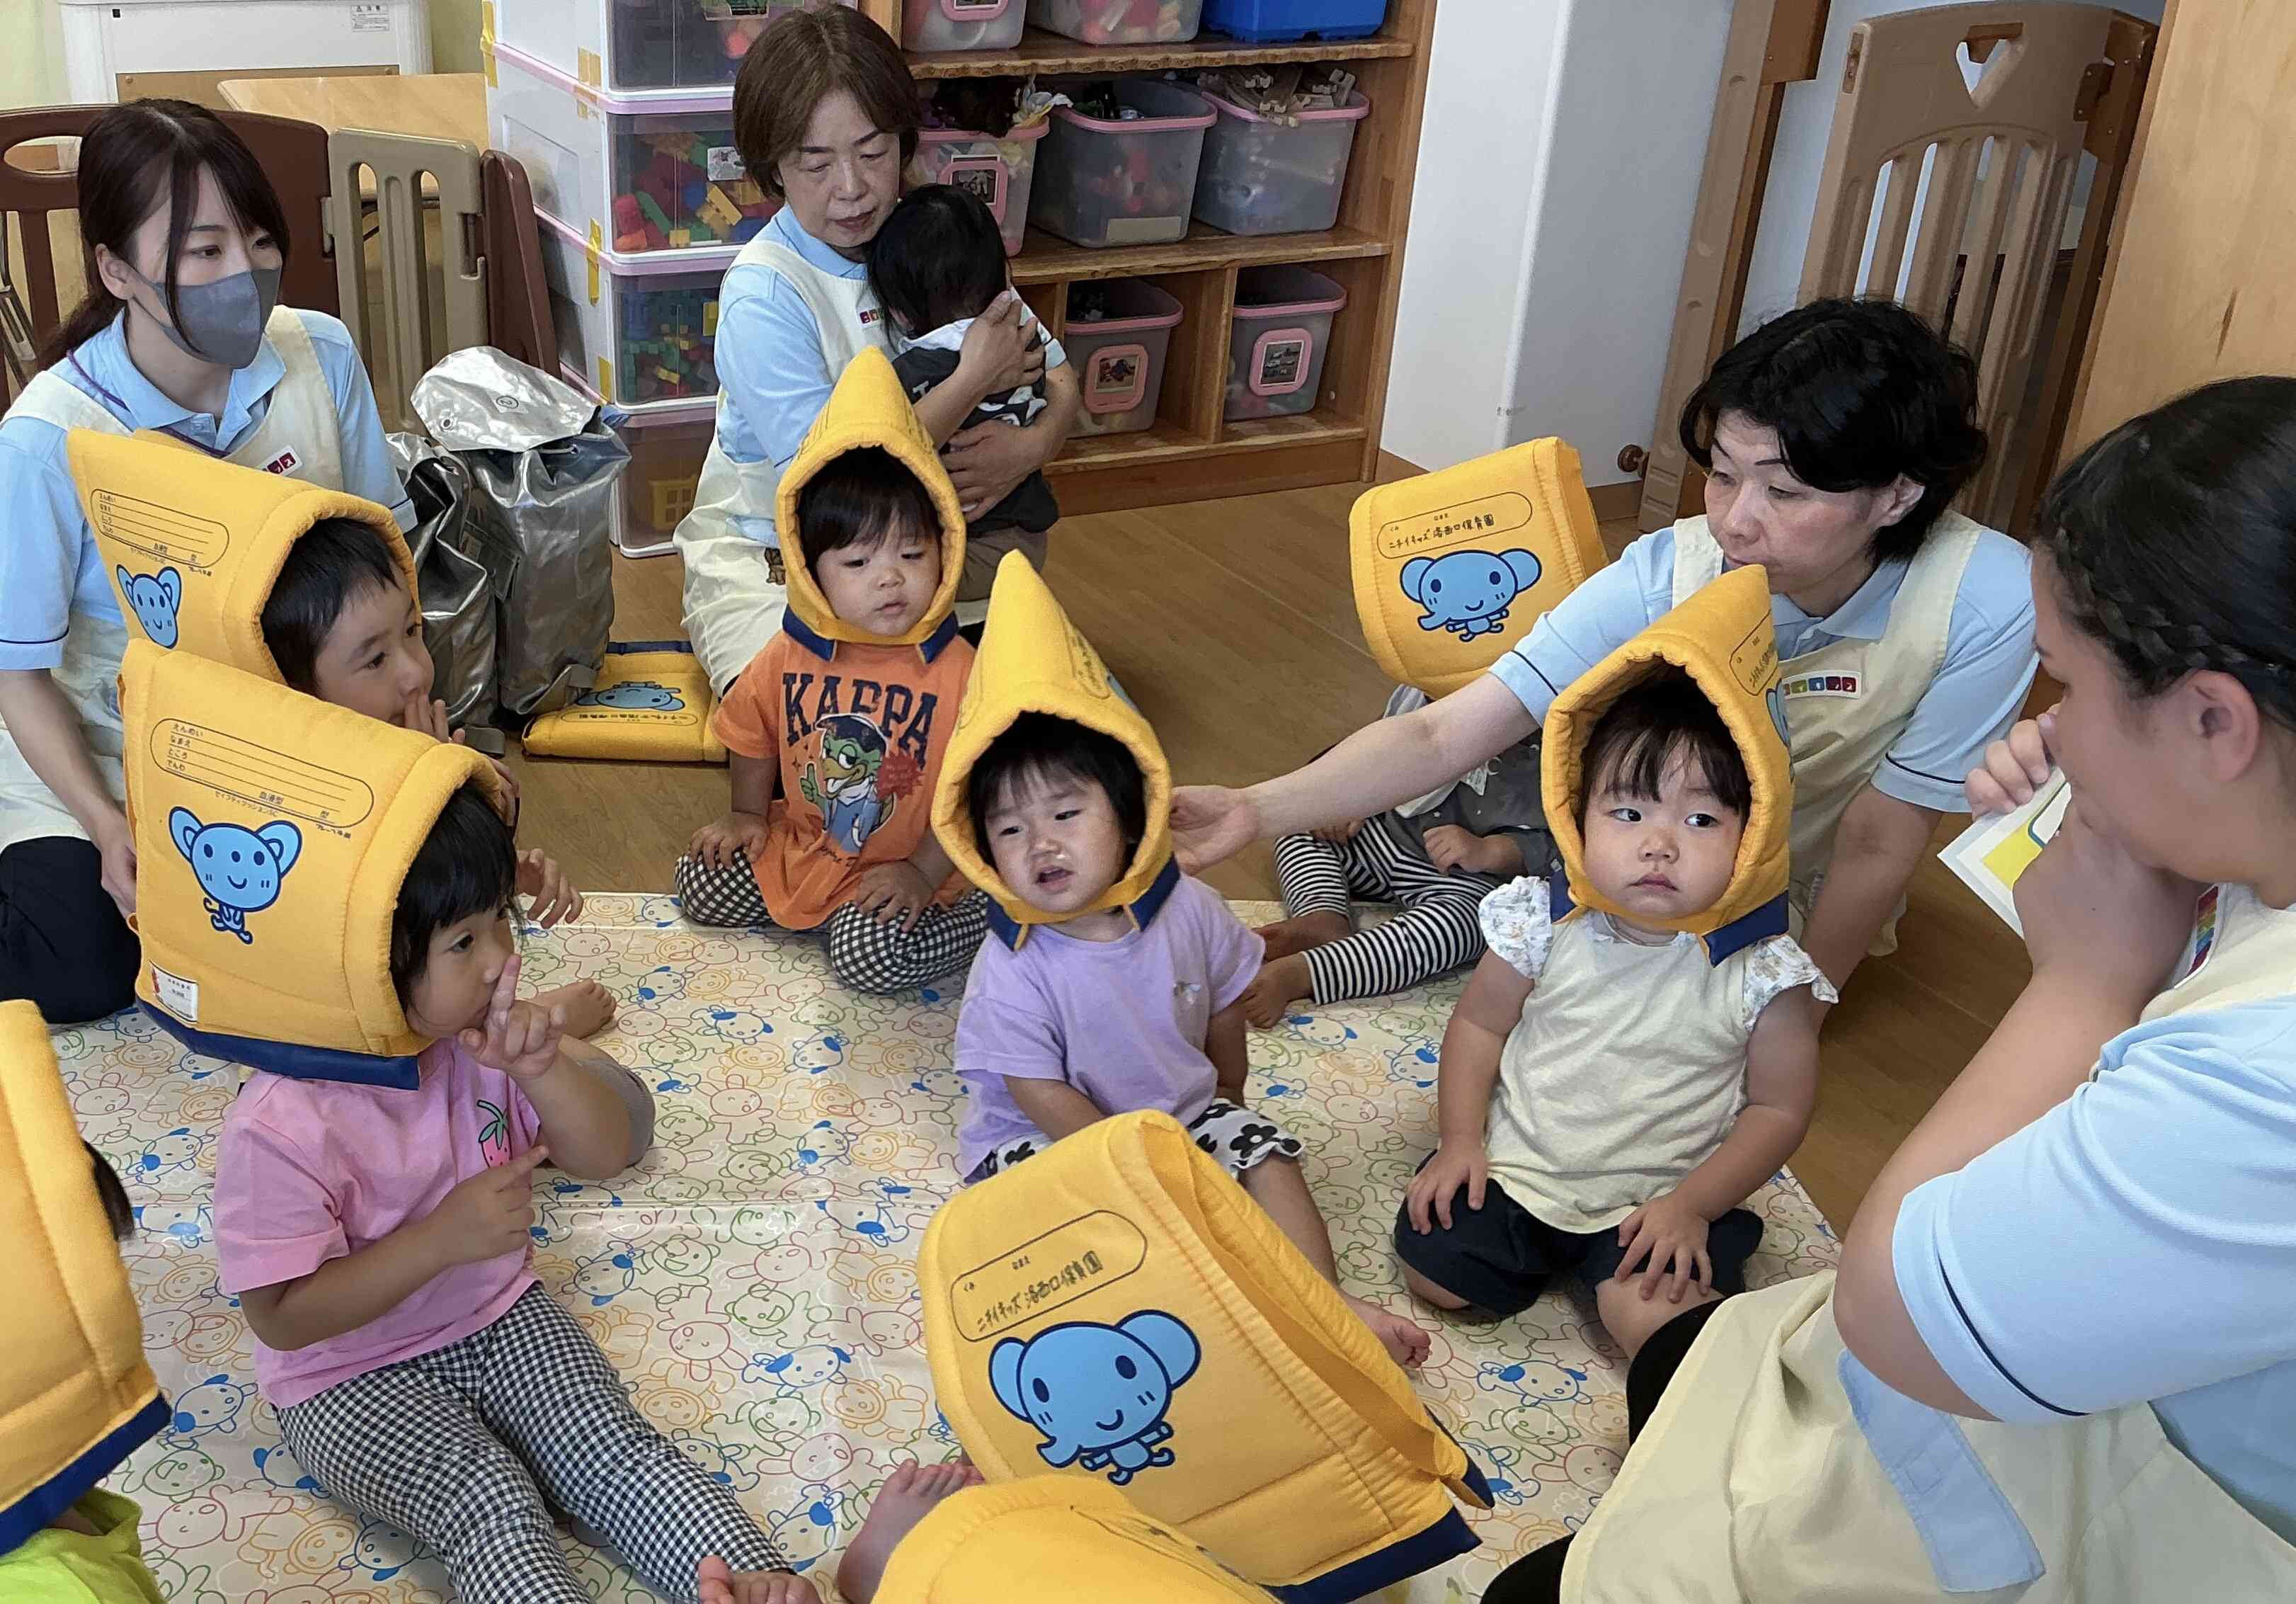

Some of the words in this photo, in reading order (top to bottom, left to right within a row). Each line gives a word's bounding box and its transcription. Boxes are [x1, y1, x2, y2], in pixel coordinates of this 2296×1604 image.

[170, 735, 190, 749] なまえ
[782, 672, 938, 771] KAPPA
